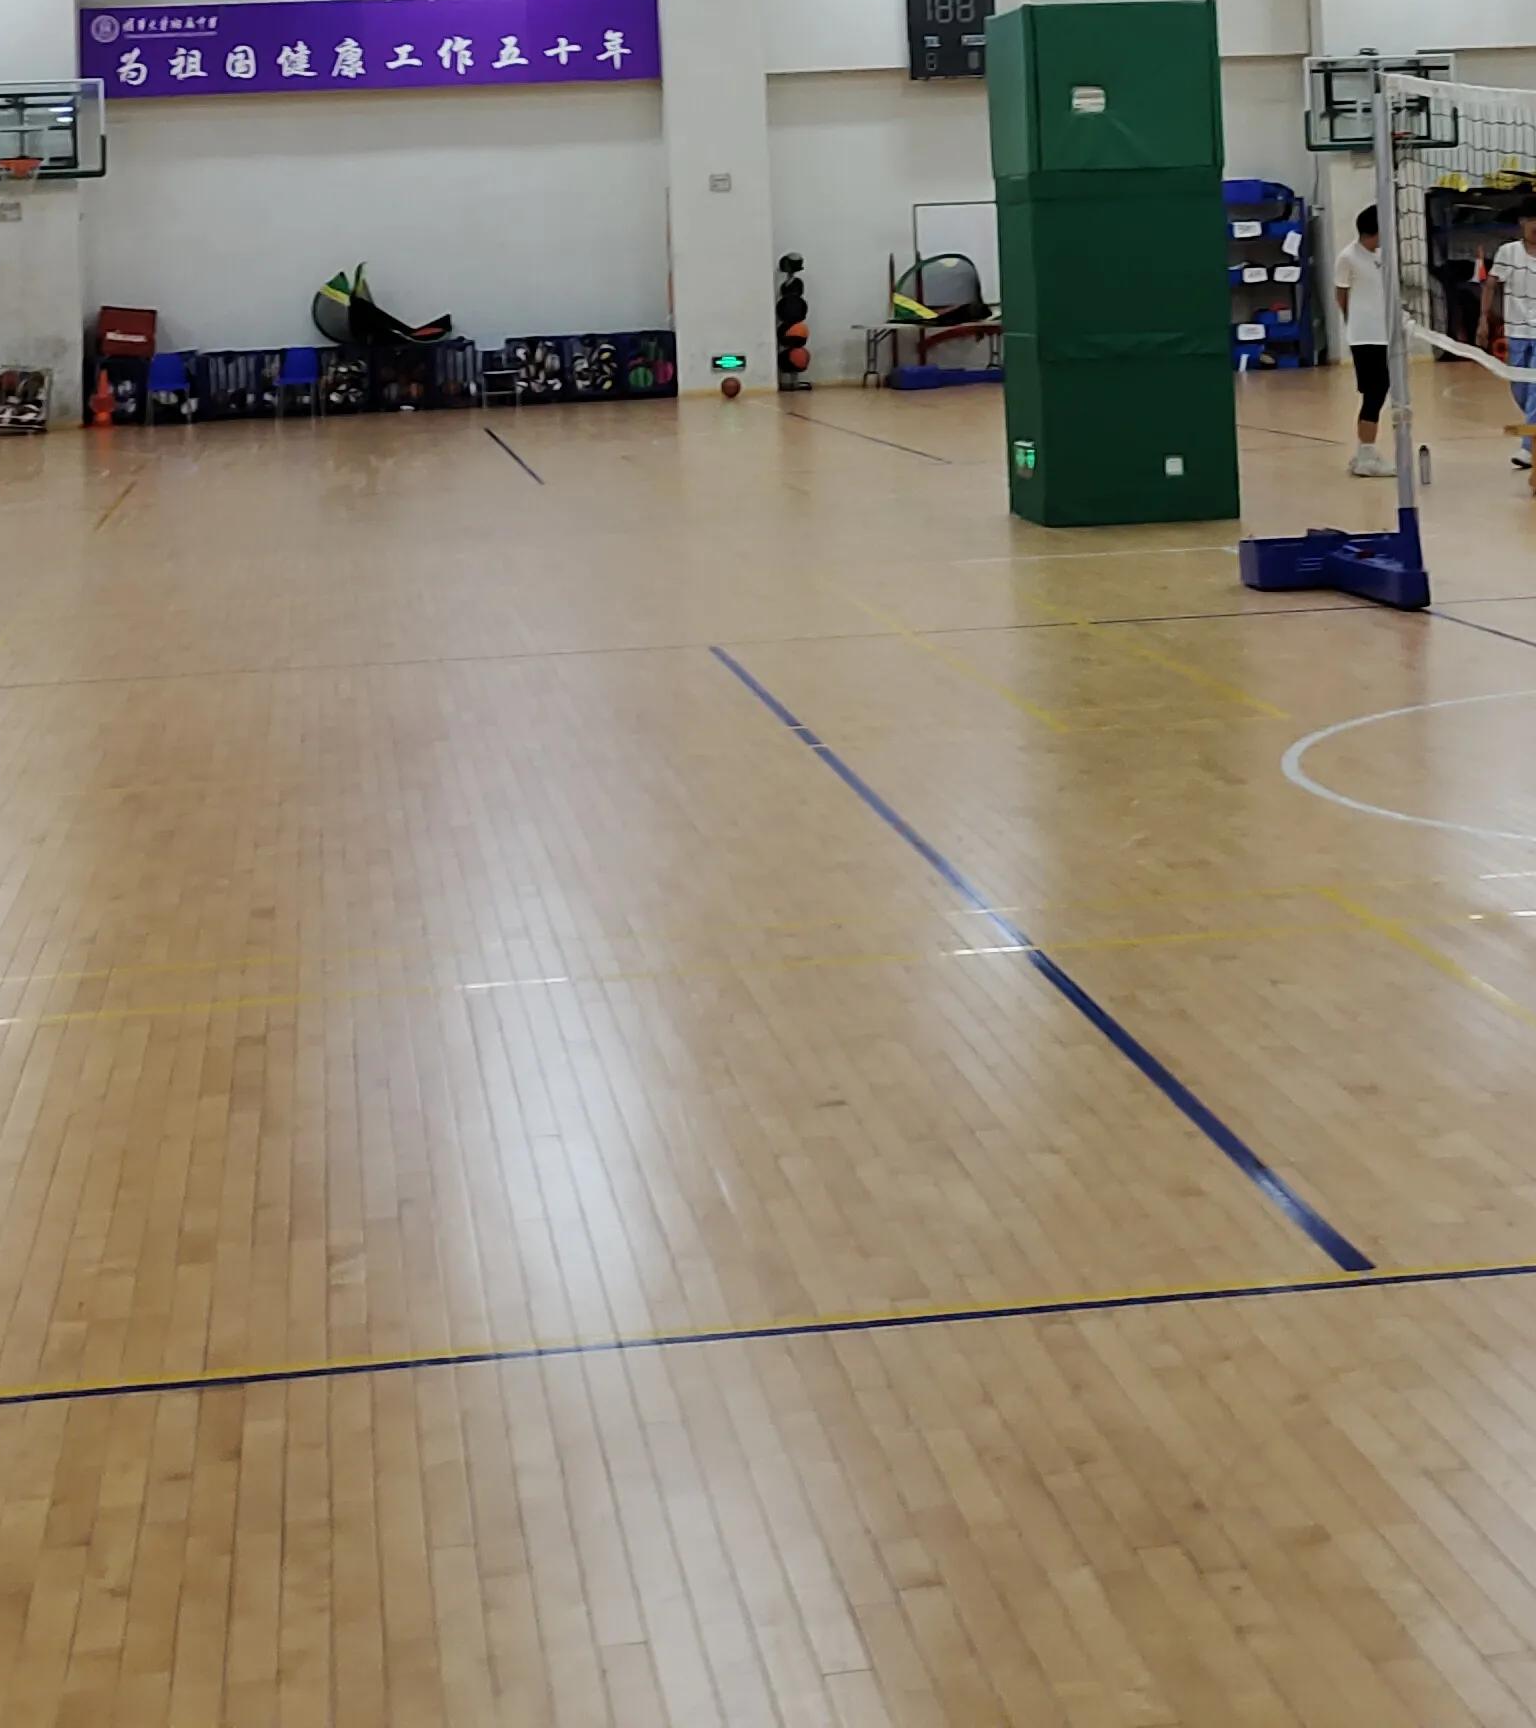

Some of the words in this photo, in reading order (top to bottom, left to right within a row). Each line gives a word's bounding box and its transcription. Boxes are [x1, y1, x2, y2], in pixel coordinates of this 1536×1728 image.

[115, 29, 632, 86] 为祖国健康工作五十年
